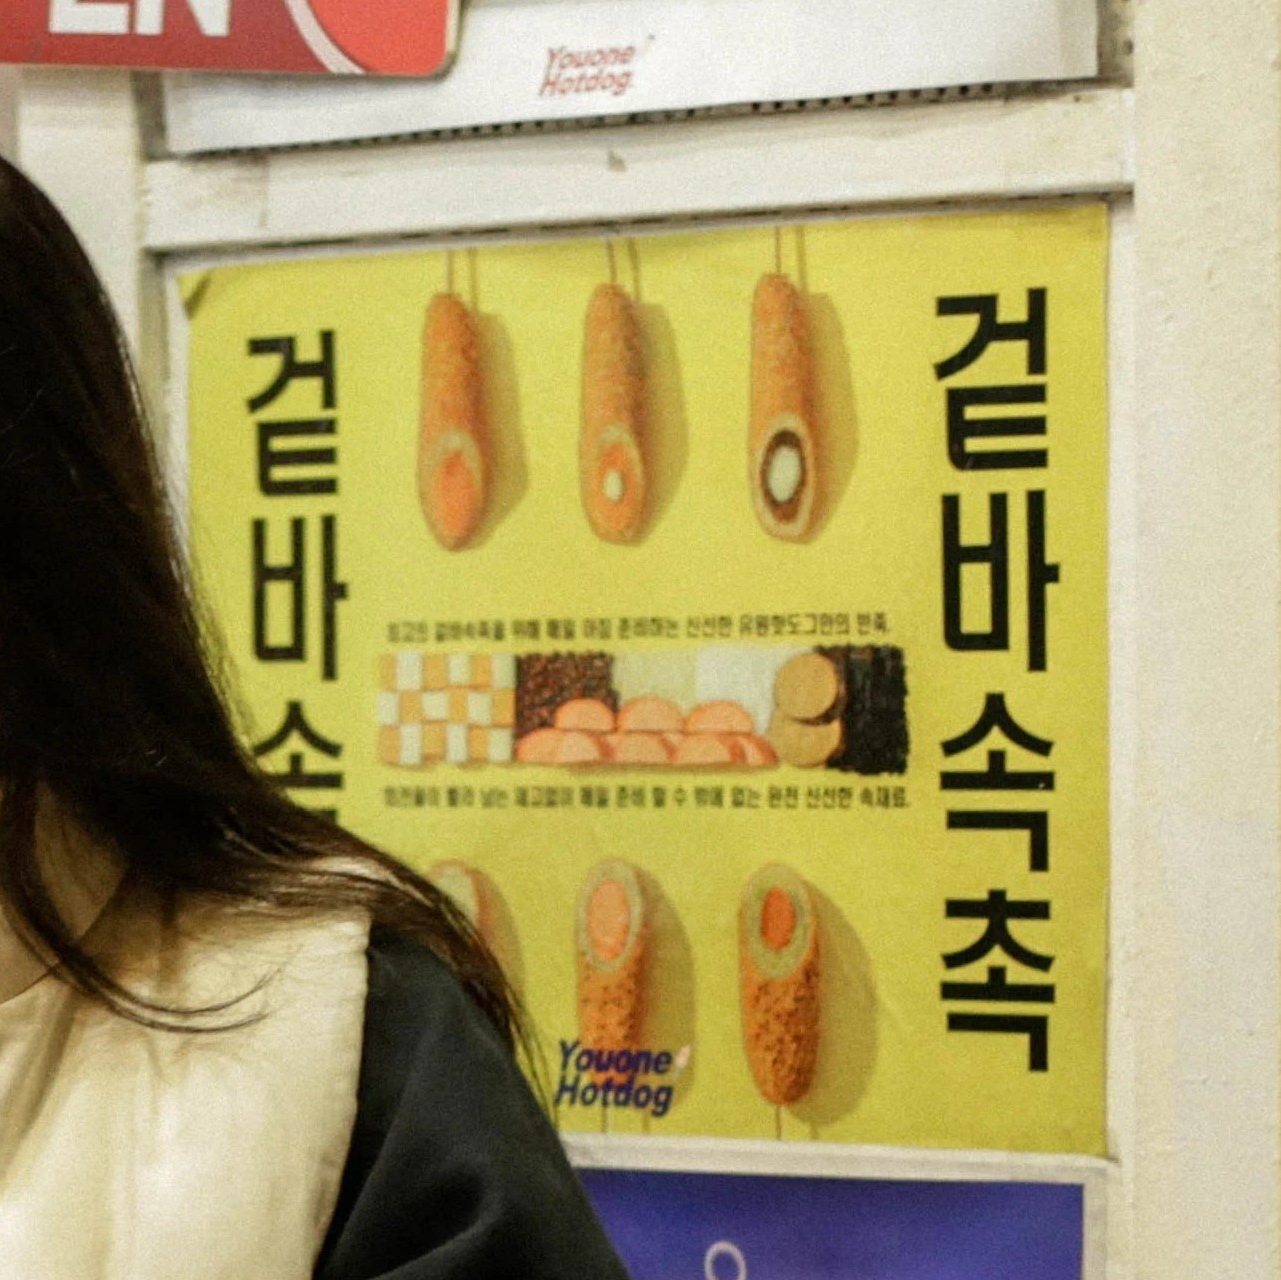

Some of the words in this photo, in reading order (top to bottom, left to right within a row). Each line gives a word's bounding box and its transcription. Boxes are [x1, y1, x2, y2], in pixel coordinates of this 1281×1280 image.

[933, 286, 1060, 1073] 겉바속촉
[558, 1038, 674, 1075] Youone
[553, 1073, 675, 1118] Hotdog
